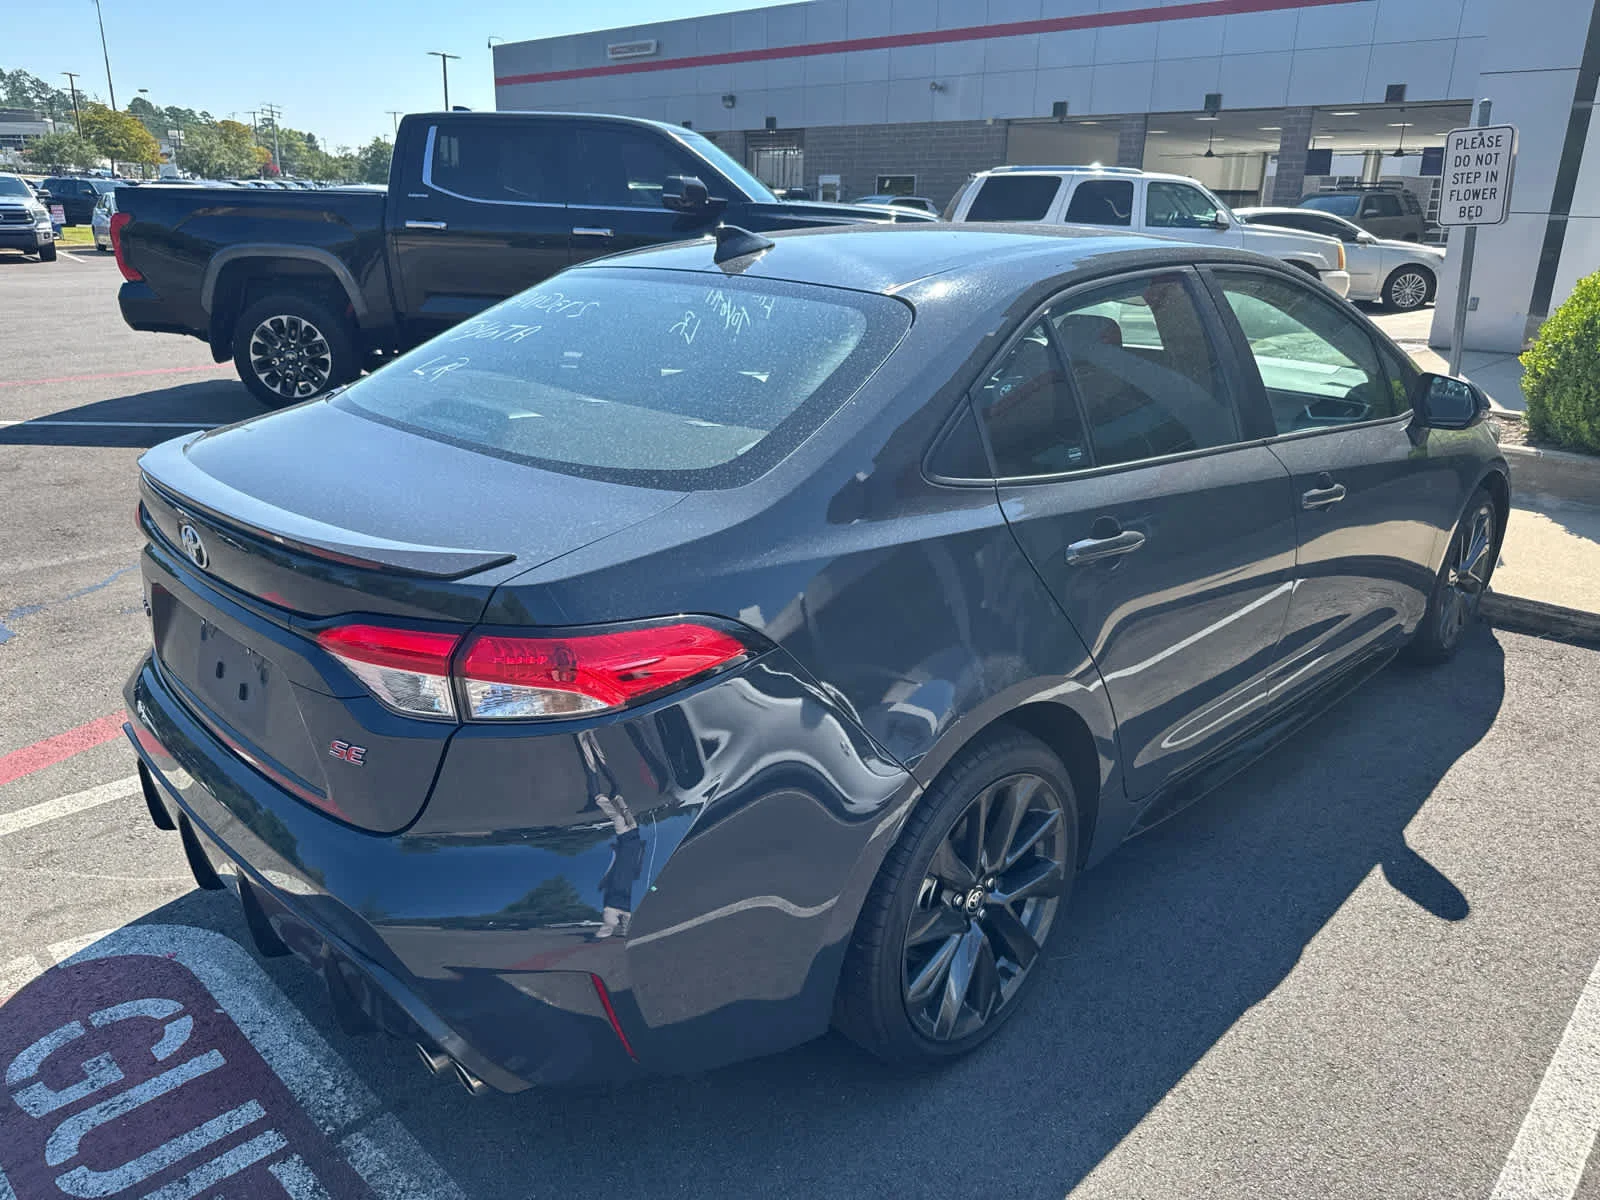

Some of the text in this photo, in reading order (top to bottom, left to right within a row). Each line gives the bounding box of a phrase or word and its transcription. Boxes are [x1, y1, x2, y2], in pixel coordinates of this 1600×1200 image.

[1455, 135, 1503, 150] PLEASE
[1454, 152, 1501, 168] DO NOT
[1452, 170, 1499, 185] STEP IN
[1449, 188, 1498, 202] FLOWER
[1459, 205, 1483, 218] BED
[328, 739, 368, 767] SE
